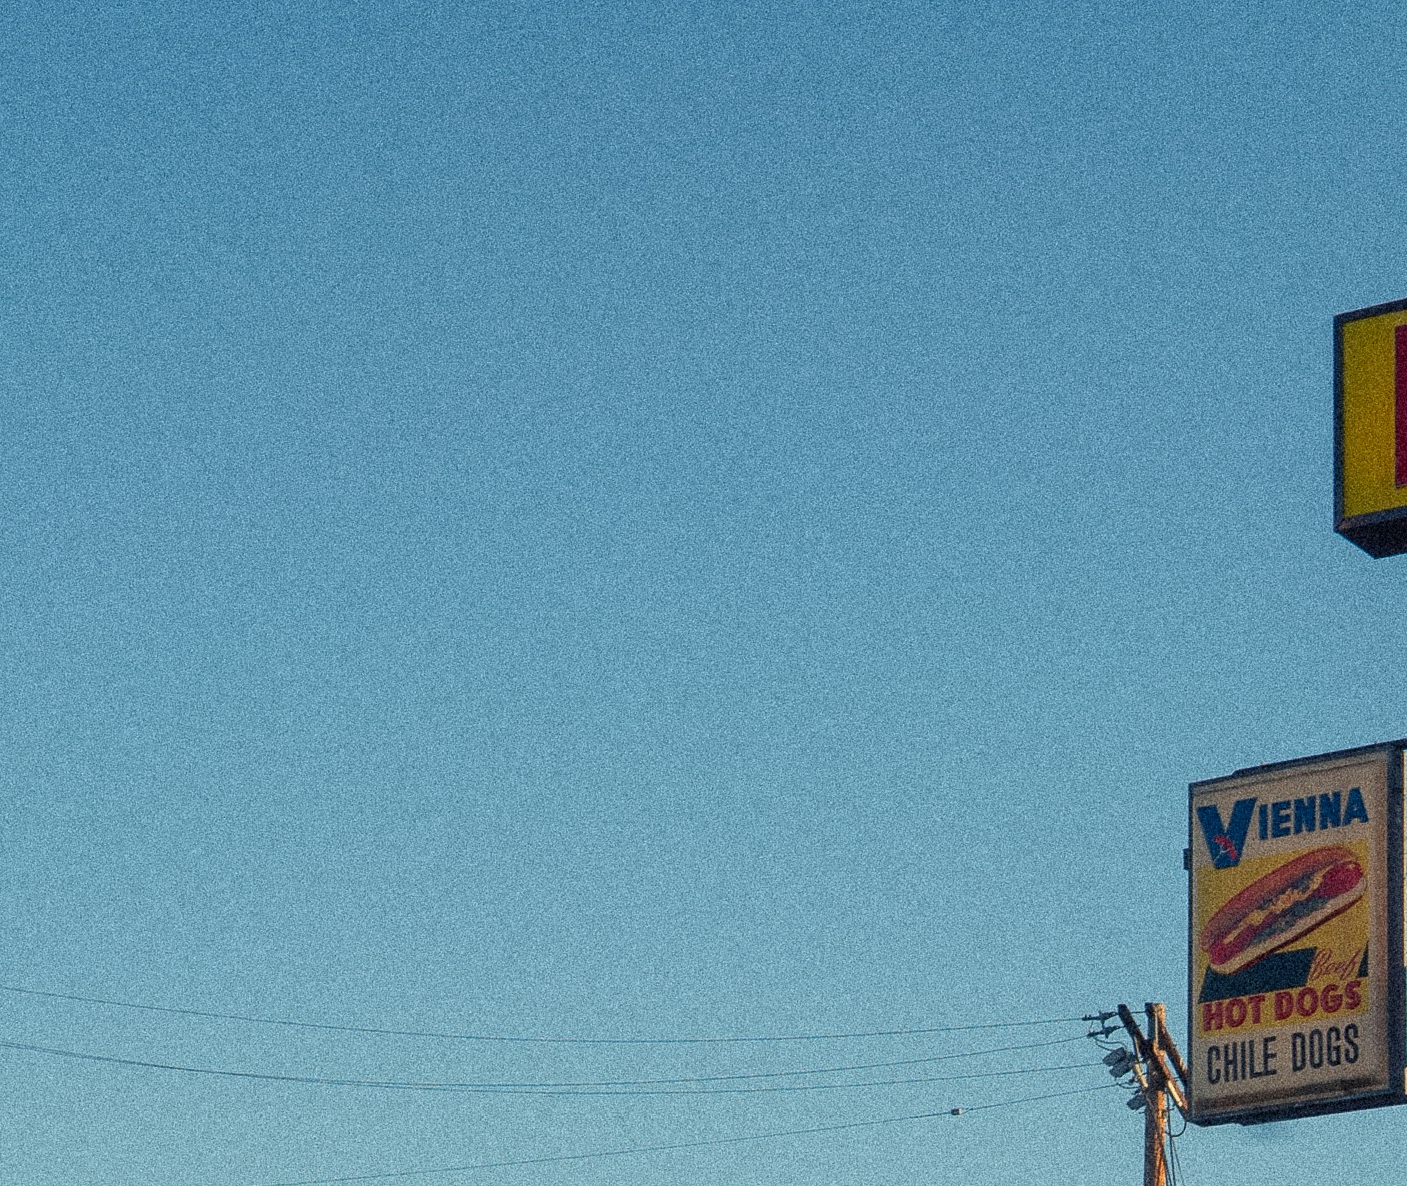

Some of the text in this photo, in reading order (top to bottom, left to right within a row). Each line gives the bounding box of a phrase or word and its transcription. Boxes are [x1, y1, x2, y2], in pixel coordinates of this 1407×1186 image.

[1197, 787, 1369, 870] VIENNA
[1202, 980, 1362, 1032] HOT DOGS
[1207, 1023, 1359, 1085] CHILE DOGS
